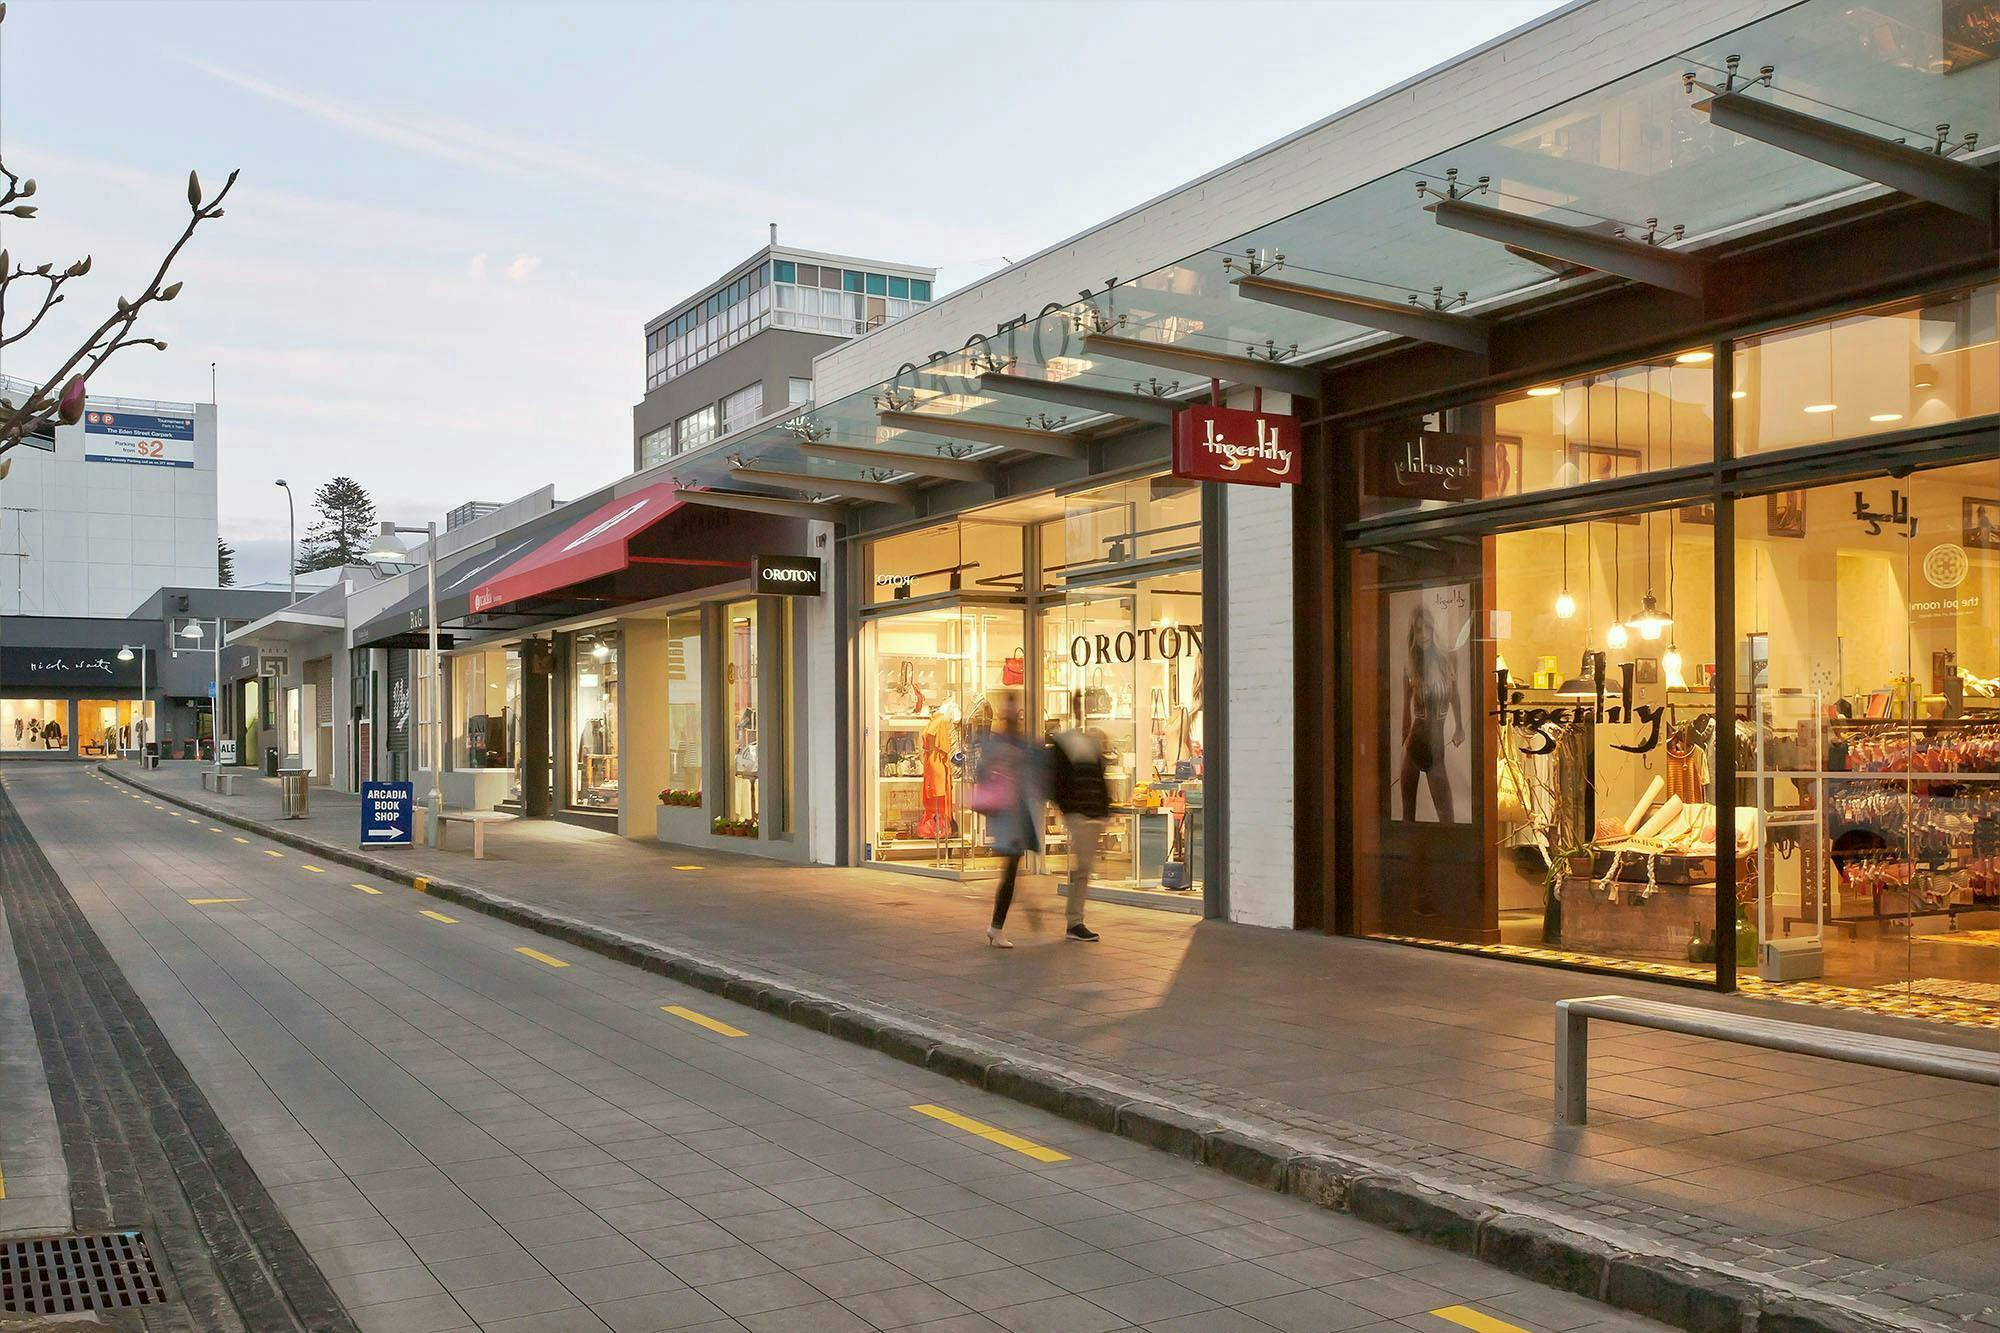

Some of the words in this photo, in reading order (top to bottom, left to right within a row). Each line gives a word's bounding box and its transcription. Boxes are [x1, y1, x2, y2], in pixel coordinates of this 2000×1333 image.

[151, 431, 173, 439] Carpark
[138, 440, 163, 458] $2
[1203, 419, 1292, 475] tigerlily
[762, 567, 817, 582] OROTON
[1071, 624, 1202, 667] OROTON
[1489, 651, 1665, 755] tigerlily
[221, 744, 236, 753] ALE
[367, 790, 407, 799] ARCADIA
[374, 801, 400, 810] BOOK
[374, 812, 400, 821] SHOP
